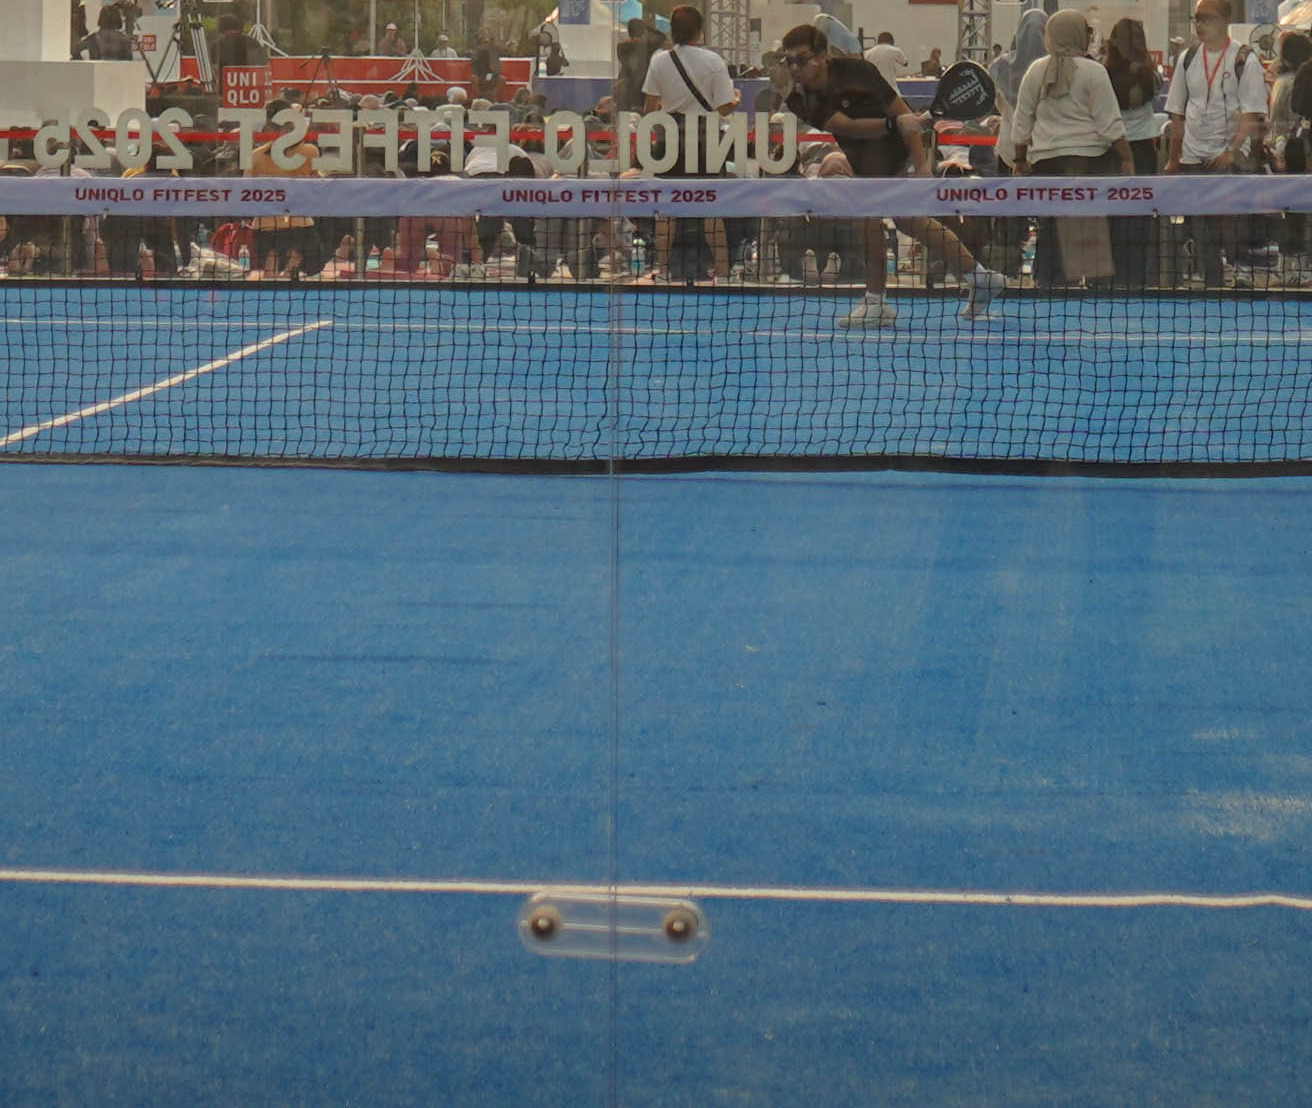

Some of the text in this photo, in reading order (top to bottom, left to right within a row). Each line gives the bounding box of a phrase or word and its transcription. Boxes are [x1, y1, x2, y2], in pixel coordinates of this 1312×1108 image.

[227, 72, 257, 87] UNI
[227, 89, 260, 106] QLO
[74, 188, 287, 203] UNIQLO FITFEST 2025
[502, 189, 717, 204] UNIQLO FITFEST 2025
[936, 187, 1154, 203] UNIQLO FITFEST 2025
